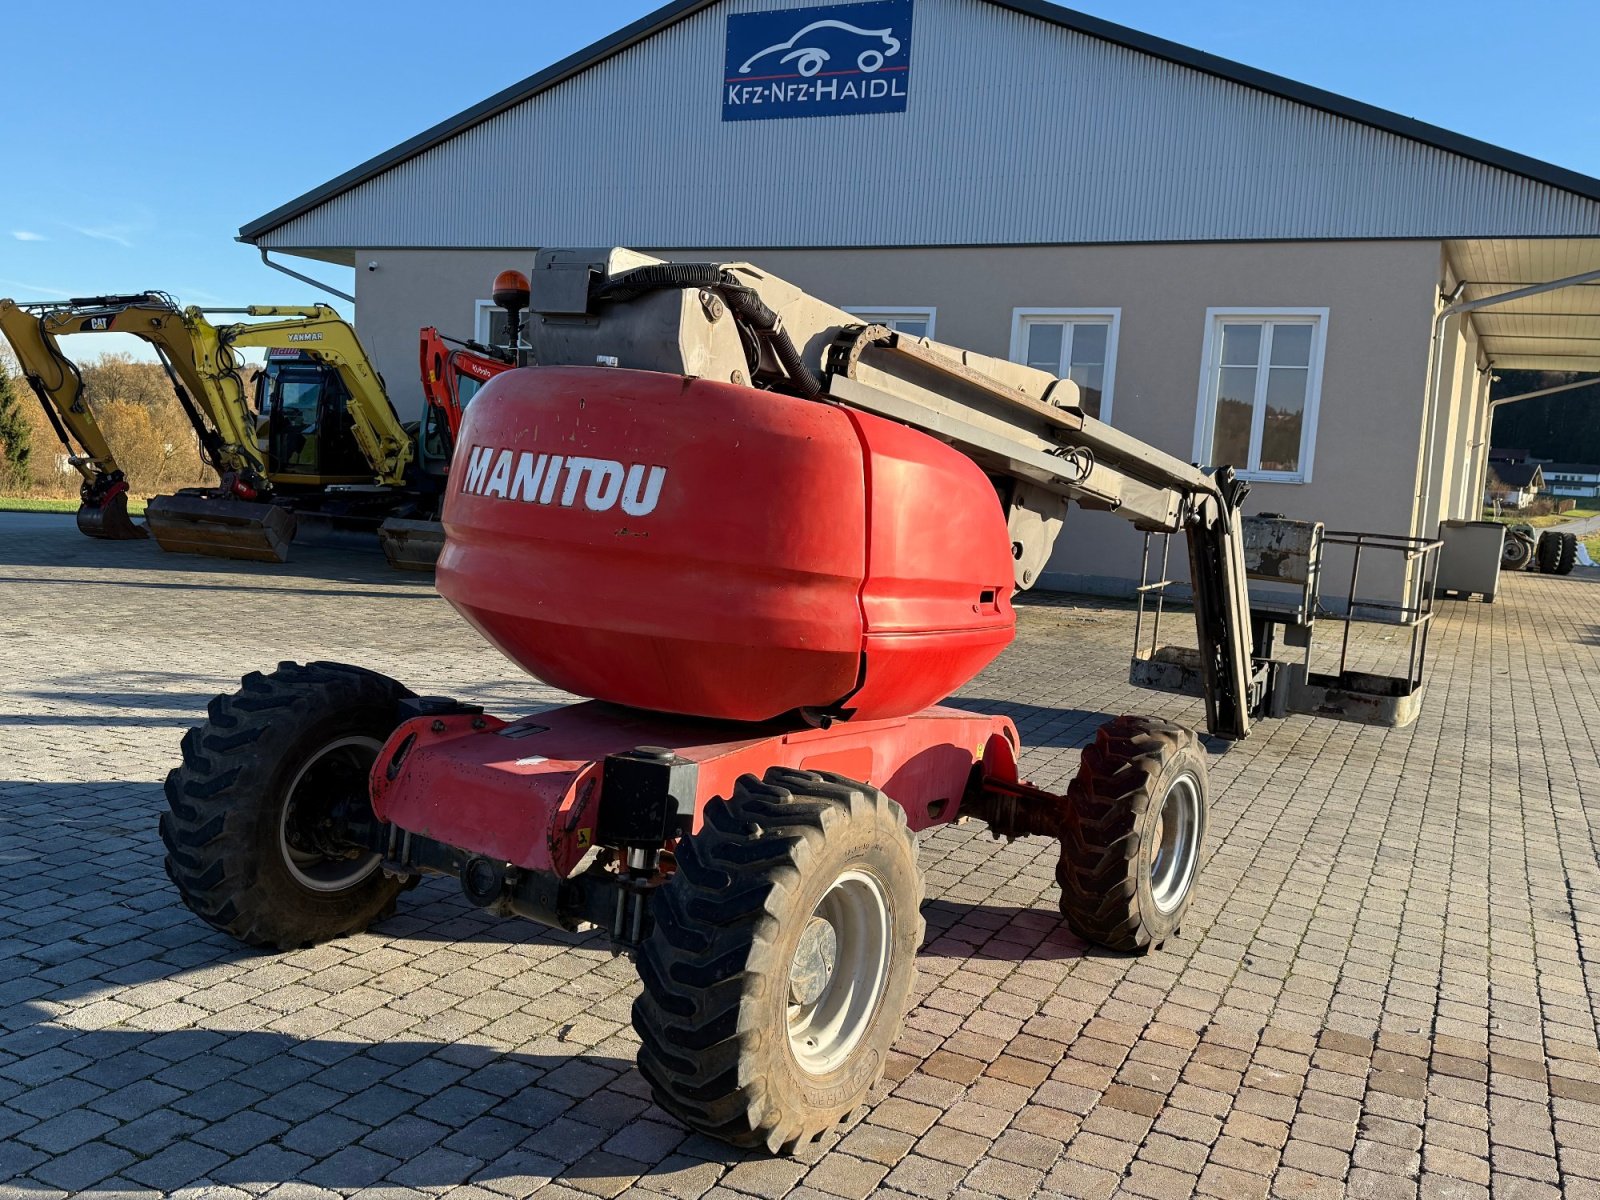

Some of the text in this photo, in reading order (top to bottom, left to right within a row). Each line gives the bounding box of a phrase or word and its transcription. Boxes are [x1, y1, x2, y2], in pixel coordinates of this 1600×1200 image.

[91, 317, 107, 330] CAT
[288, 332, 324, 342] YANMAR
[462, 446, 667, 517] MANITOU
